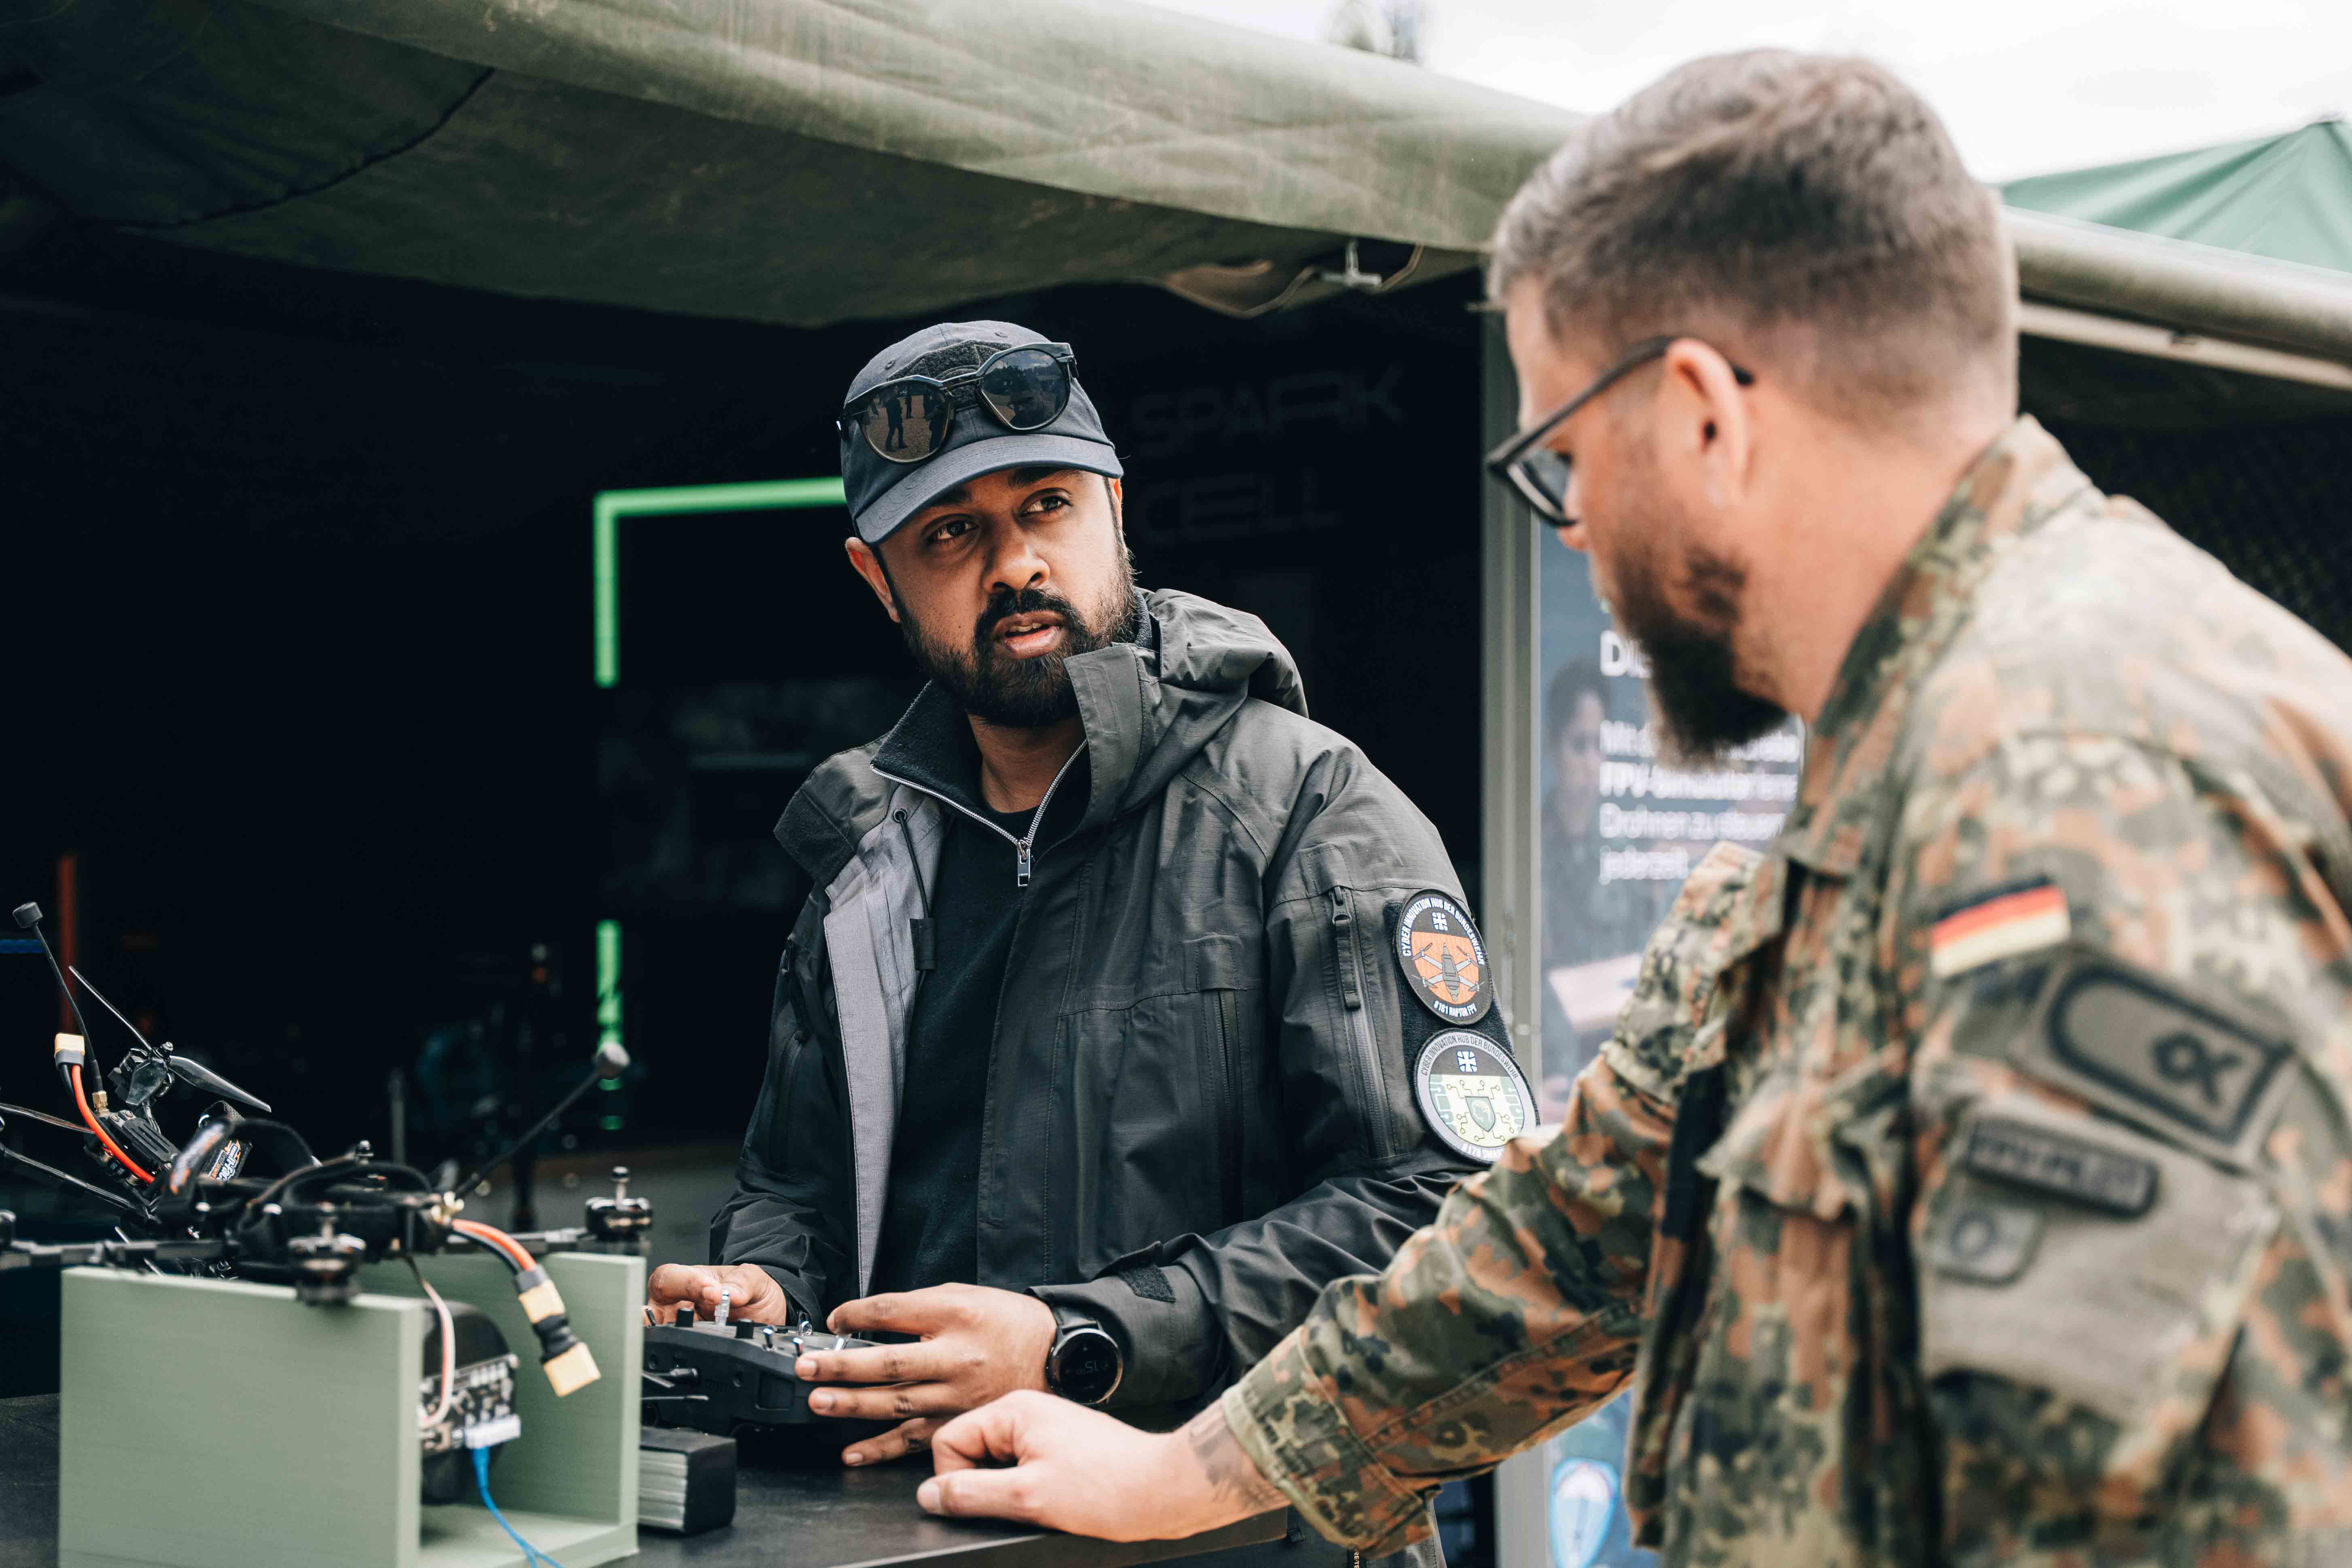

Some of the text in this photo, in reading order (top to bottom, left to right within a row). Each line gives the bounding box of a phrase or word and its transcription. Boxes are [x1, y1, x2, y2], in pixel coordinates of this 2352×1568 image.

[1130, 360, 1408, 459] SPARK
[1133, 467, 1344, 544] CELL
[1401, 898, 1485, 965] CYBER INNOVATION HUB DER BUNDESWEHR
[1434, 1000, 1477, 1017] #181 RAPTOR FPV
[1421, 1035, 1518, 1079] CYBER INNOVATION HUB DER BUNDESWEHR
